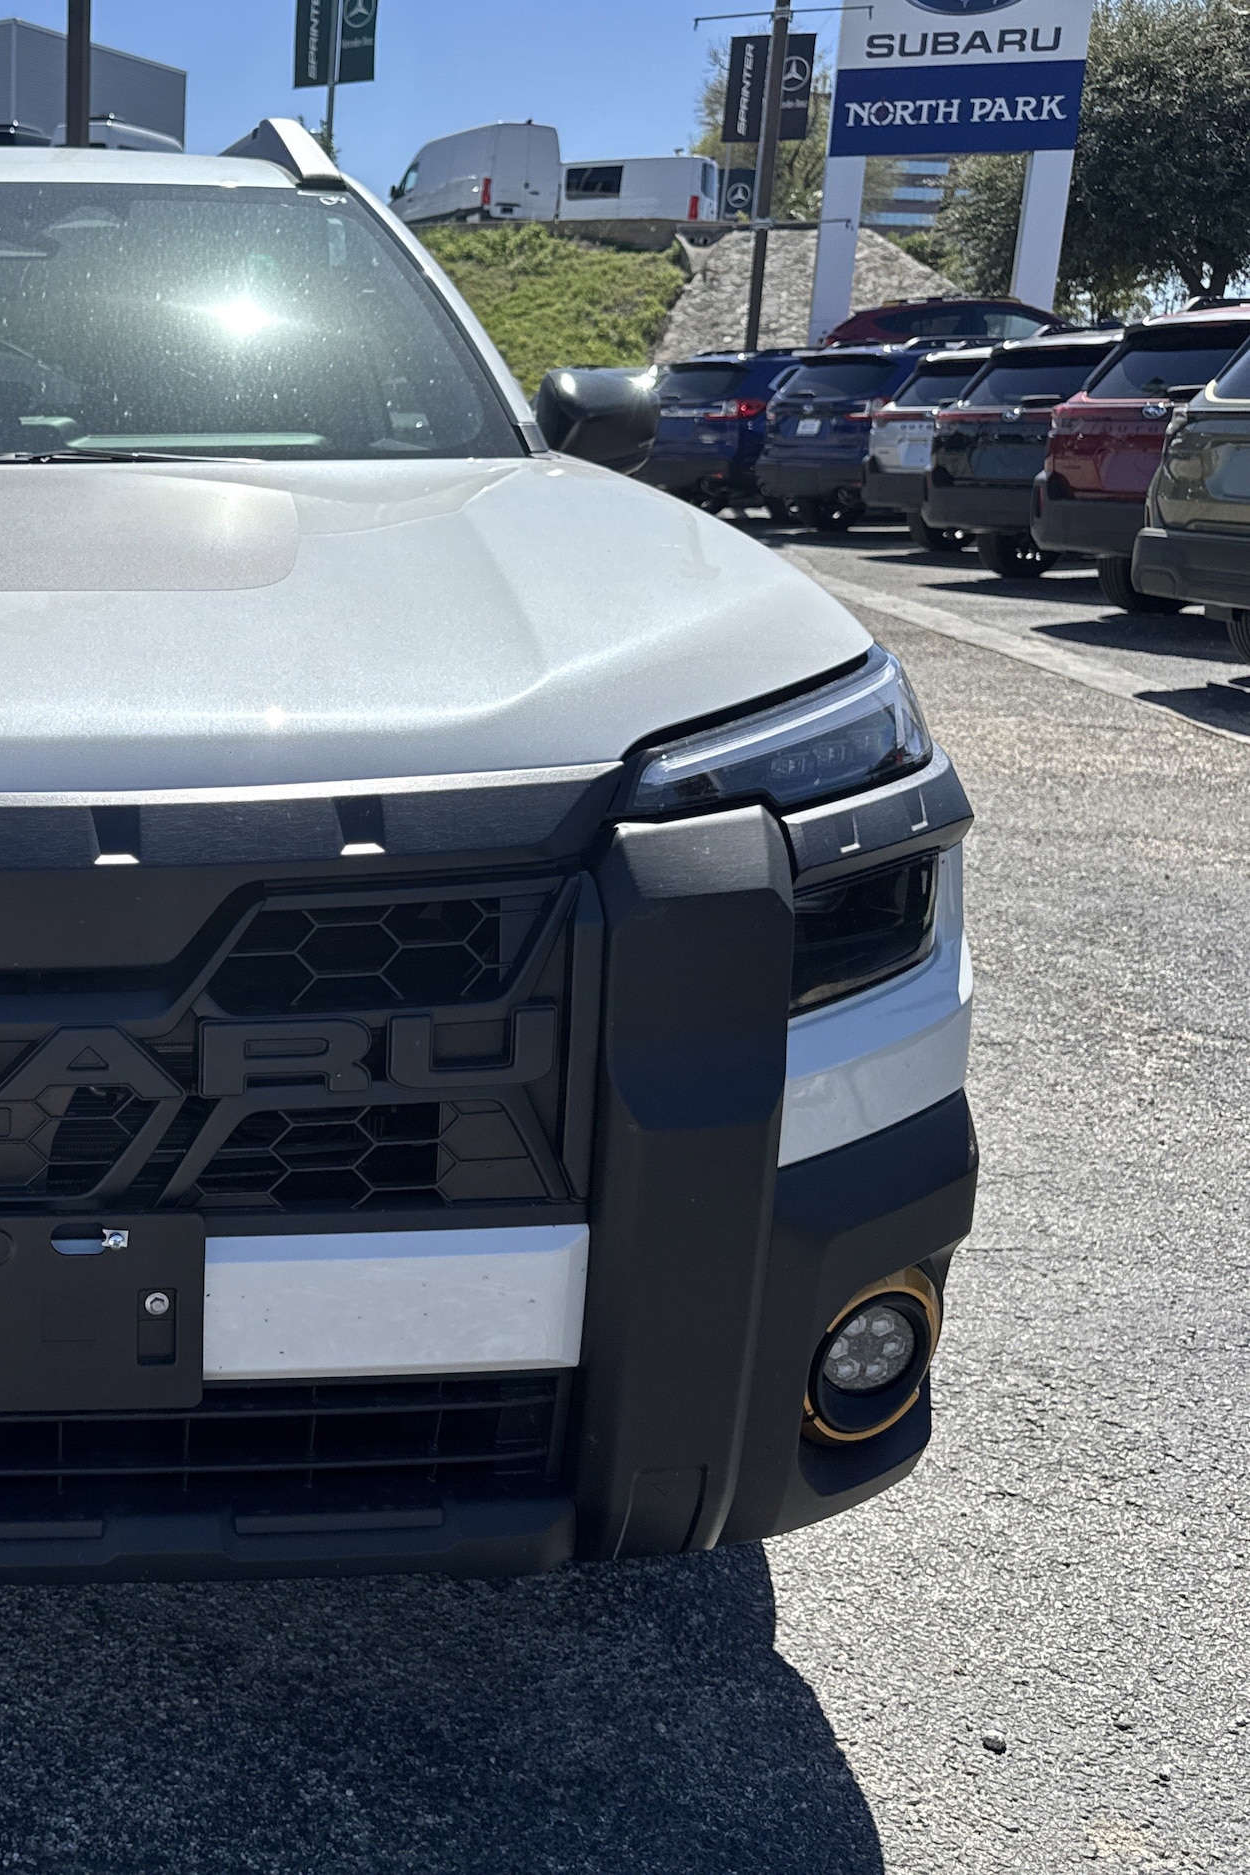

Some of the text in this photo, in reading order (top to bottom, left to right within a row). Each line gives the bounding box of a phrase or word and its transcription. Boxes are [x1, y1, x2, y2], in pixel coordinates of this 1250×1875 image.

[865, 26, 1062, 59] SUBARU
[736, 42, 755, 136] SPRINTER
[845, 95, 1068, 128] NORTH PARK
